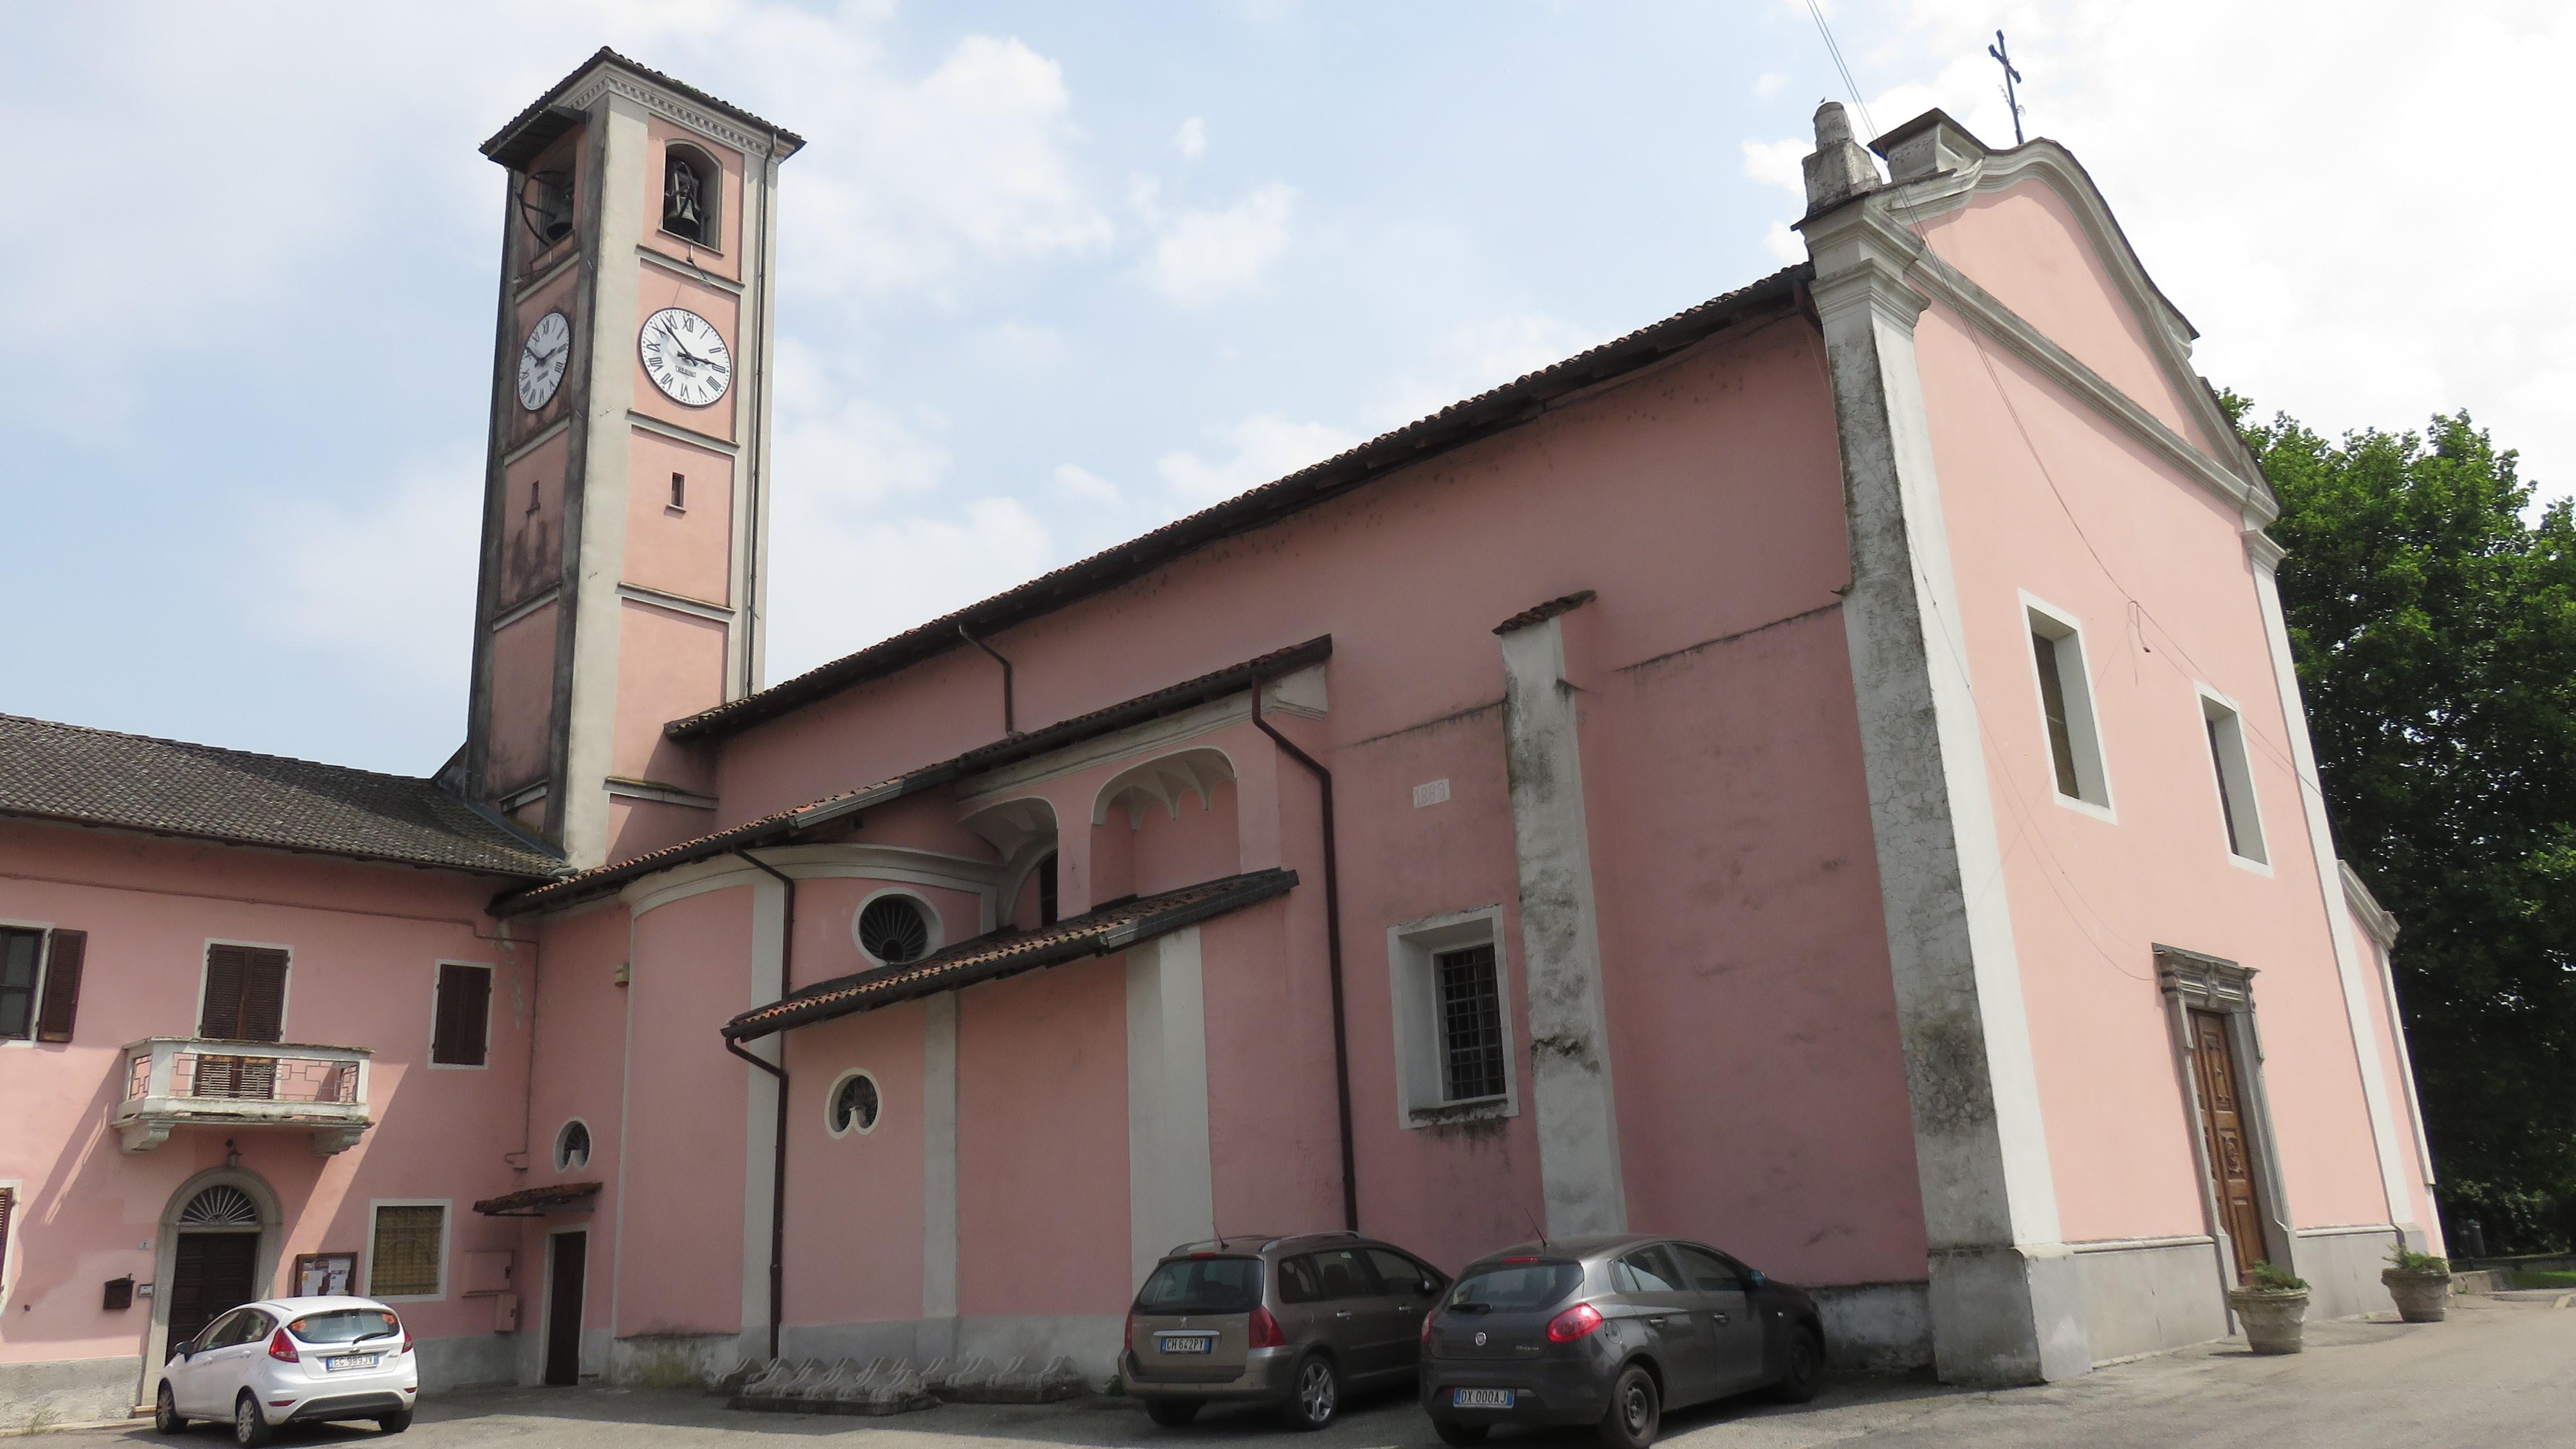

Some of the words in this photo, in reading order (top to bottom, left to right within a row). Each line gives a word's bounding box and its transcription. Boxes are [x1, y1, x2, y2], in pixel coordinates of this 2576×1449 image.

[651, 322, 666, 338] X
[664, 314, 678, 330] XI
[682, 315, 694, 333] XII
[700, 329, 709, 340] I
[643, 338, 661, 353] IX
[648, 357, 664, 373] VIII
[712, 364, 726, 374] III
[660, 372, 674, 392] VII
[680, 382, 690, 400] VI
[697, 384, 708, 400] V
[1166, 1338, 1177, 1350] CH
[1178, 1338, 1204, 1350] 642PY
[1461, 1390, 1473, 1403] DX
[1476, 1390, 1507, 1404] 000AJ
